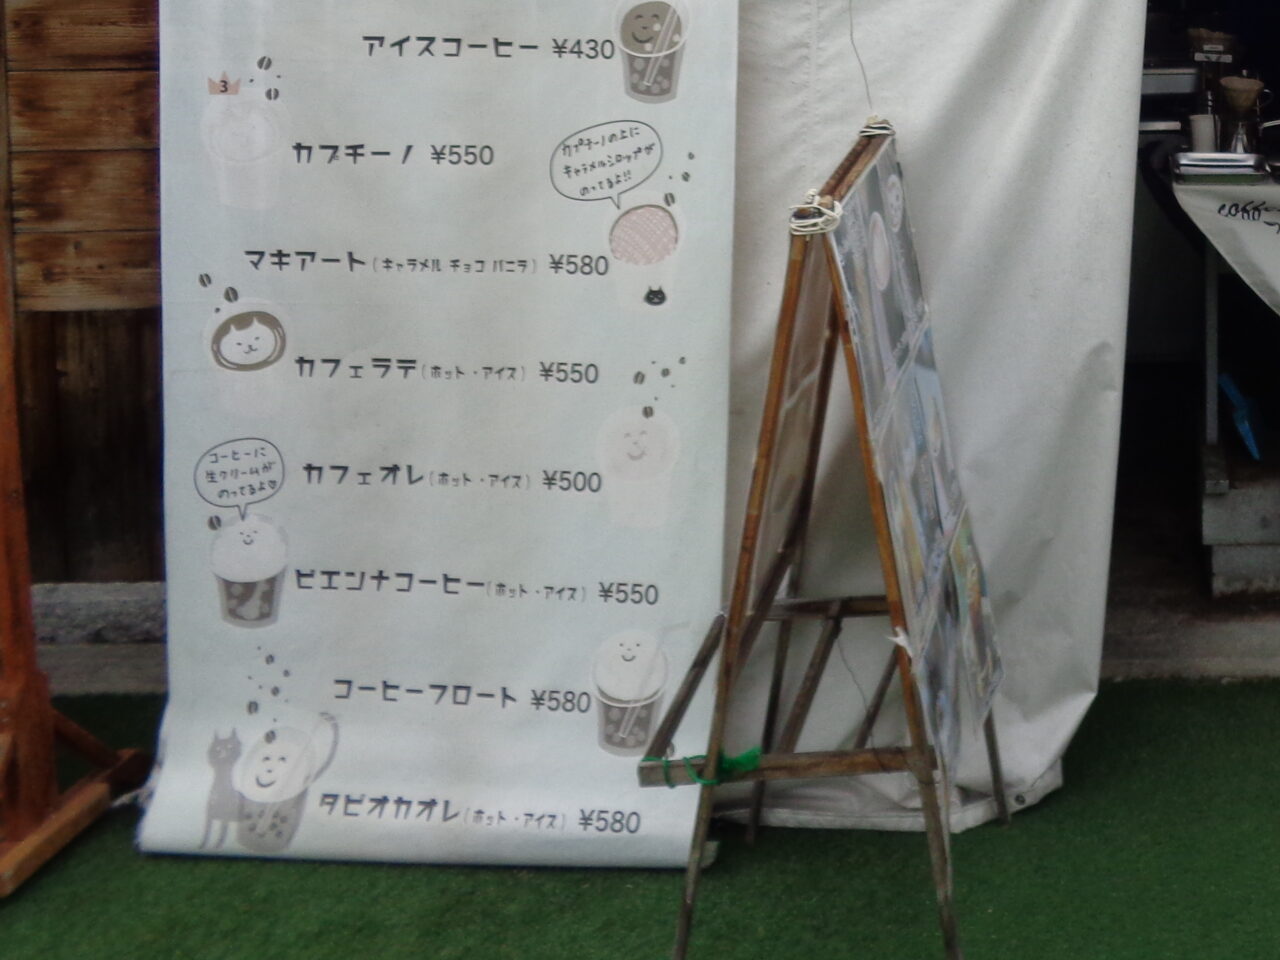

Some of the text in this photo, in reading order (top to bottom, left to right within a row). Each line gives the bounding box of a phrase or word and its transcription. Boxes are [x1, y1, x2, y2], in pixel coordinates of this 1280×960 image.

[362, 35, 613, 59] アイスコーヒー ¥430
[218, 80, 229, 94] 3
[292, 142, 494, 165] カプチーノ ¥550
[549, 254, 609, 276] ¥580
[539, 361, 599, 384] ¥550
[542, 470, 602, 493] ¥500
[598, 582, 659, 605] ¥550
[334, 679, 591, 713] コーヒーフロート ¥580
[579, 809, 641, 833] ¥580
